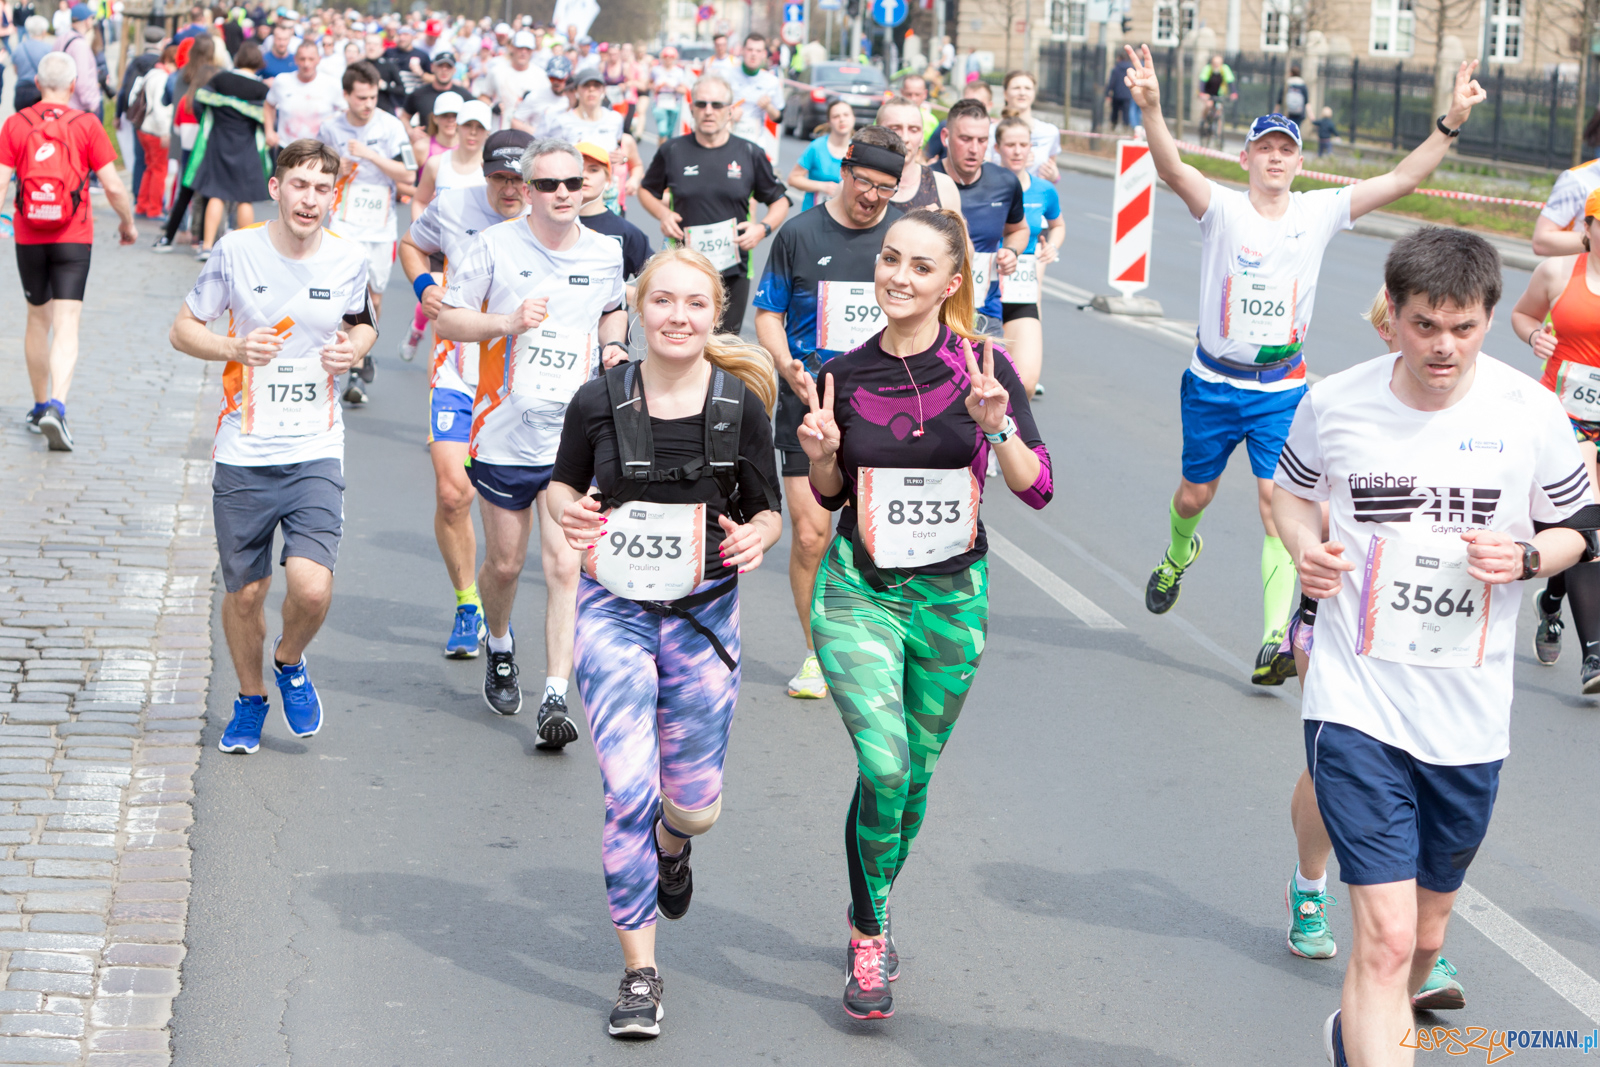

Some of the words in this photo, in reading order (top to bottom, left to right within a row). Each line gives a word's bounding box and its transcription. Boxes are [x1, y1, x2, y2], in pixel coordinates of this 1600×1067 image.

[354, 197, 382, 210] 5768
[698, 236, 731, 252] 2594
[817, 256, 832, 266] 4F
[253, 285, 268, 294] 4F
[844, 305, 881, 323] 599
[1241, 298, 1285, 317] 1026
[528, 346, 577, 370] 7537
[267, 383, 317, 402] 1753
[713, 422, 731, 431] 4F
[1348, 472, 1417, 489] finisher
[887, 500, 961, 525] 8333
[912, 531, 937, 540] Edyta
[610, 531, 682, 560] 9633
[629, 563, 660, 572] Paulina
[1418, 558, 1439, 567] 11.PKO
[1390, 581, 1475, 618] 3564
[1421, 622, 1441, 633] Filip
